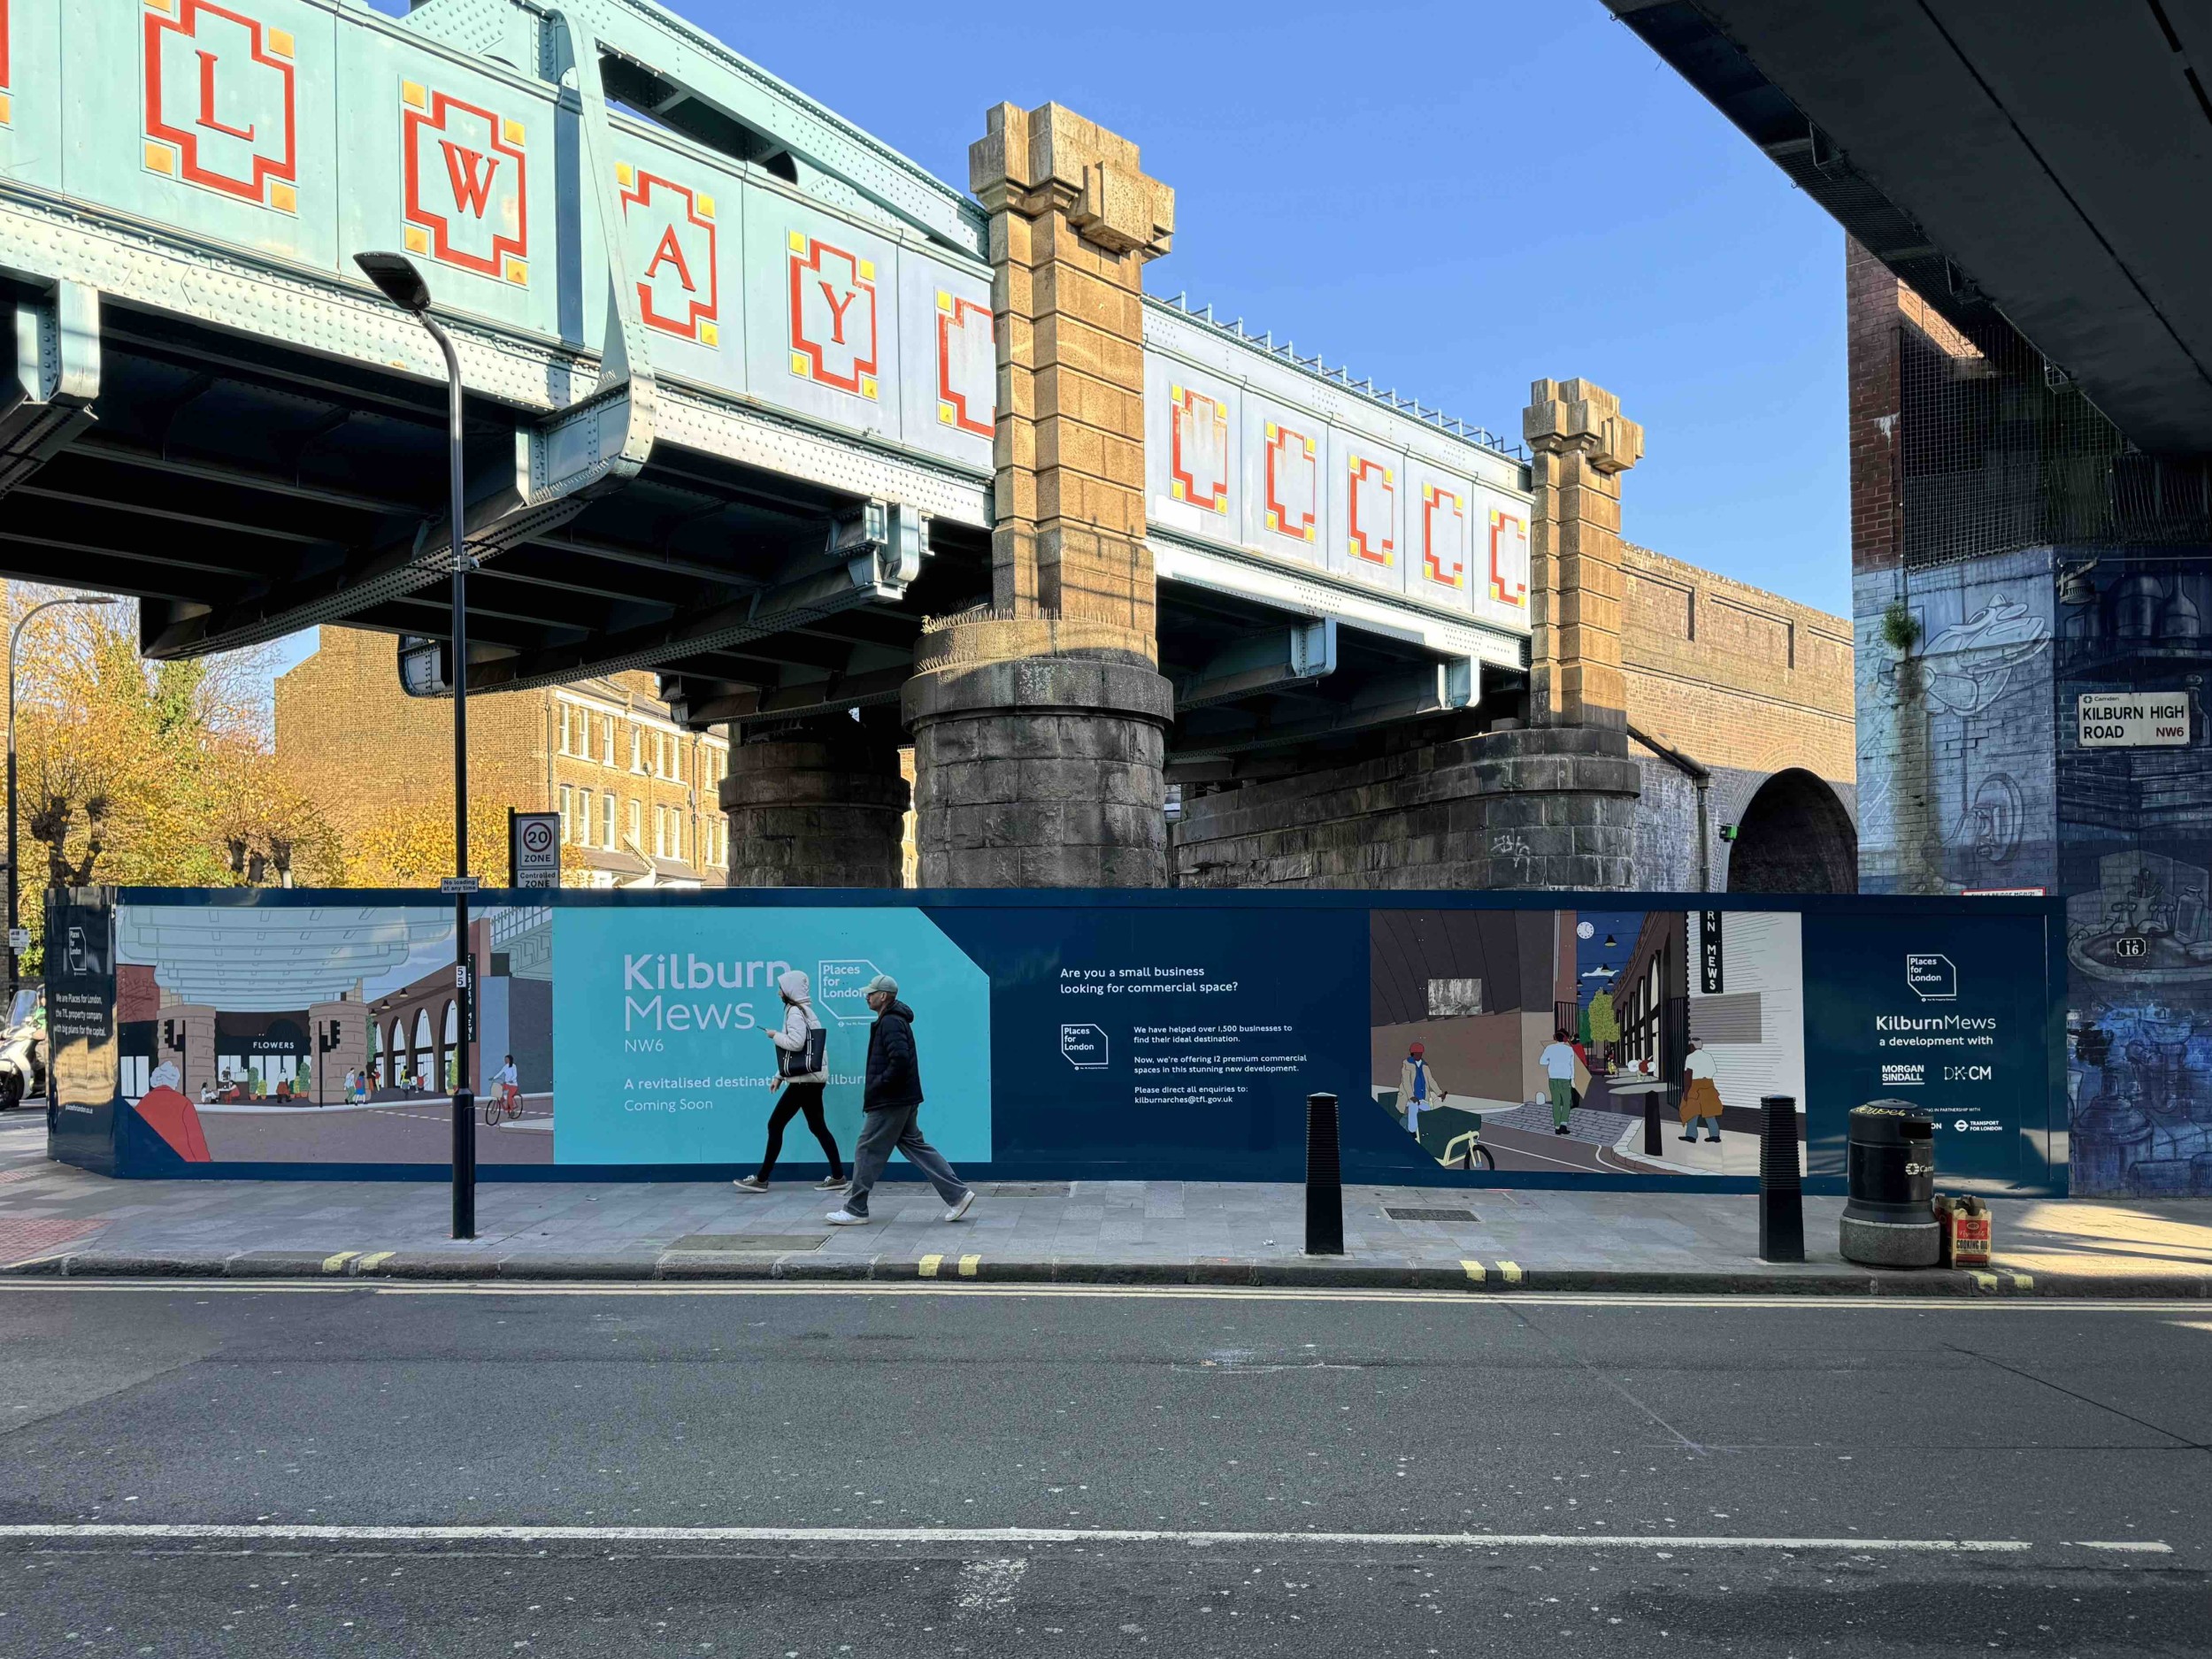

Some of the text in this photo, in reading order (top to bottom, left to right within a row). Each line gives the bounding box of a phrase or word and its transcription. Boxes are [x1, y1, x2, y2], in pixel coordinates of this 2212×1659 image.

[2083, 705, 2184, 720] KILBURN HIGH
[2084, 726, 2185, 739] ROAD NW6
[527, 831, 548, 843] 20
[2126, 944, 2139, 955] 16
[624, 953, 791, 990] Kilburn
[823, 964, 860, 974] Places
[1060, 968, 1080, 978] Are
[1084, 970, 1105, 979] you
[1118, 967, 1150, 977] small
[1155, 967, 1204, 976] business
[1707, 944, 1717, 990] MEWS
[823, 976, 840, 986] for
[1060, 982, 1238, 995] looking for commercial space?
[68, 993, 81, 1003] Places
[68, 1010, 86, 1021] property
[87, 1012, 103, 1023] company
[625, 995, 755, 1031] Mews
[68, 1025, 79, 1035] plans
[625, 1039, 664, 1052] NW6
[1889, 1036, 1964, 1048] development
[1968, 1036, 1993, 1045] with
[624, 1079, 634, 1089] A
[638, 1077, 710, 1088] revitalised
[715, 1076, 772, 1087] destinat
[1882, 1072, 1923, 1081] SINDALL
[624, 1099, 713, 1112] Coming Soon
[1134, 1095, 1233, 1104] kilburnarches@tfl.gov.uk
[1956, 1240, 1979, 1249] COOKING
